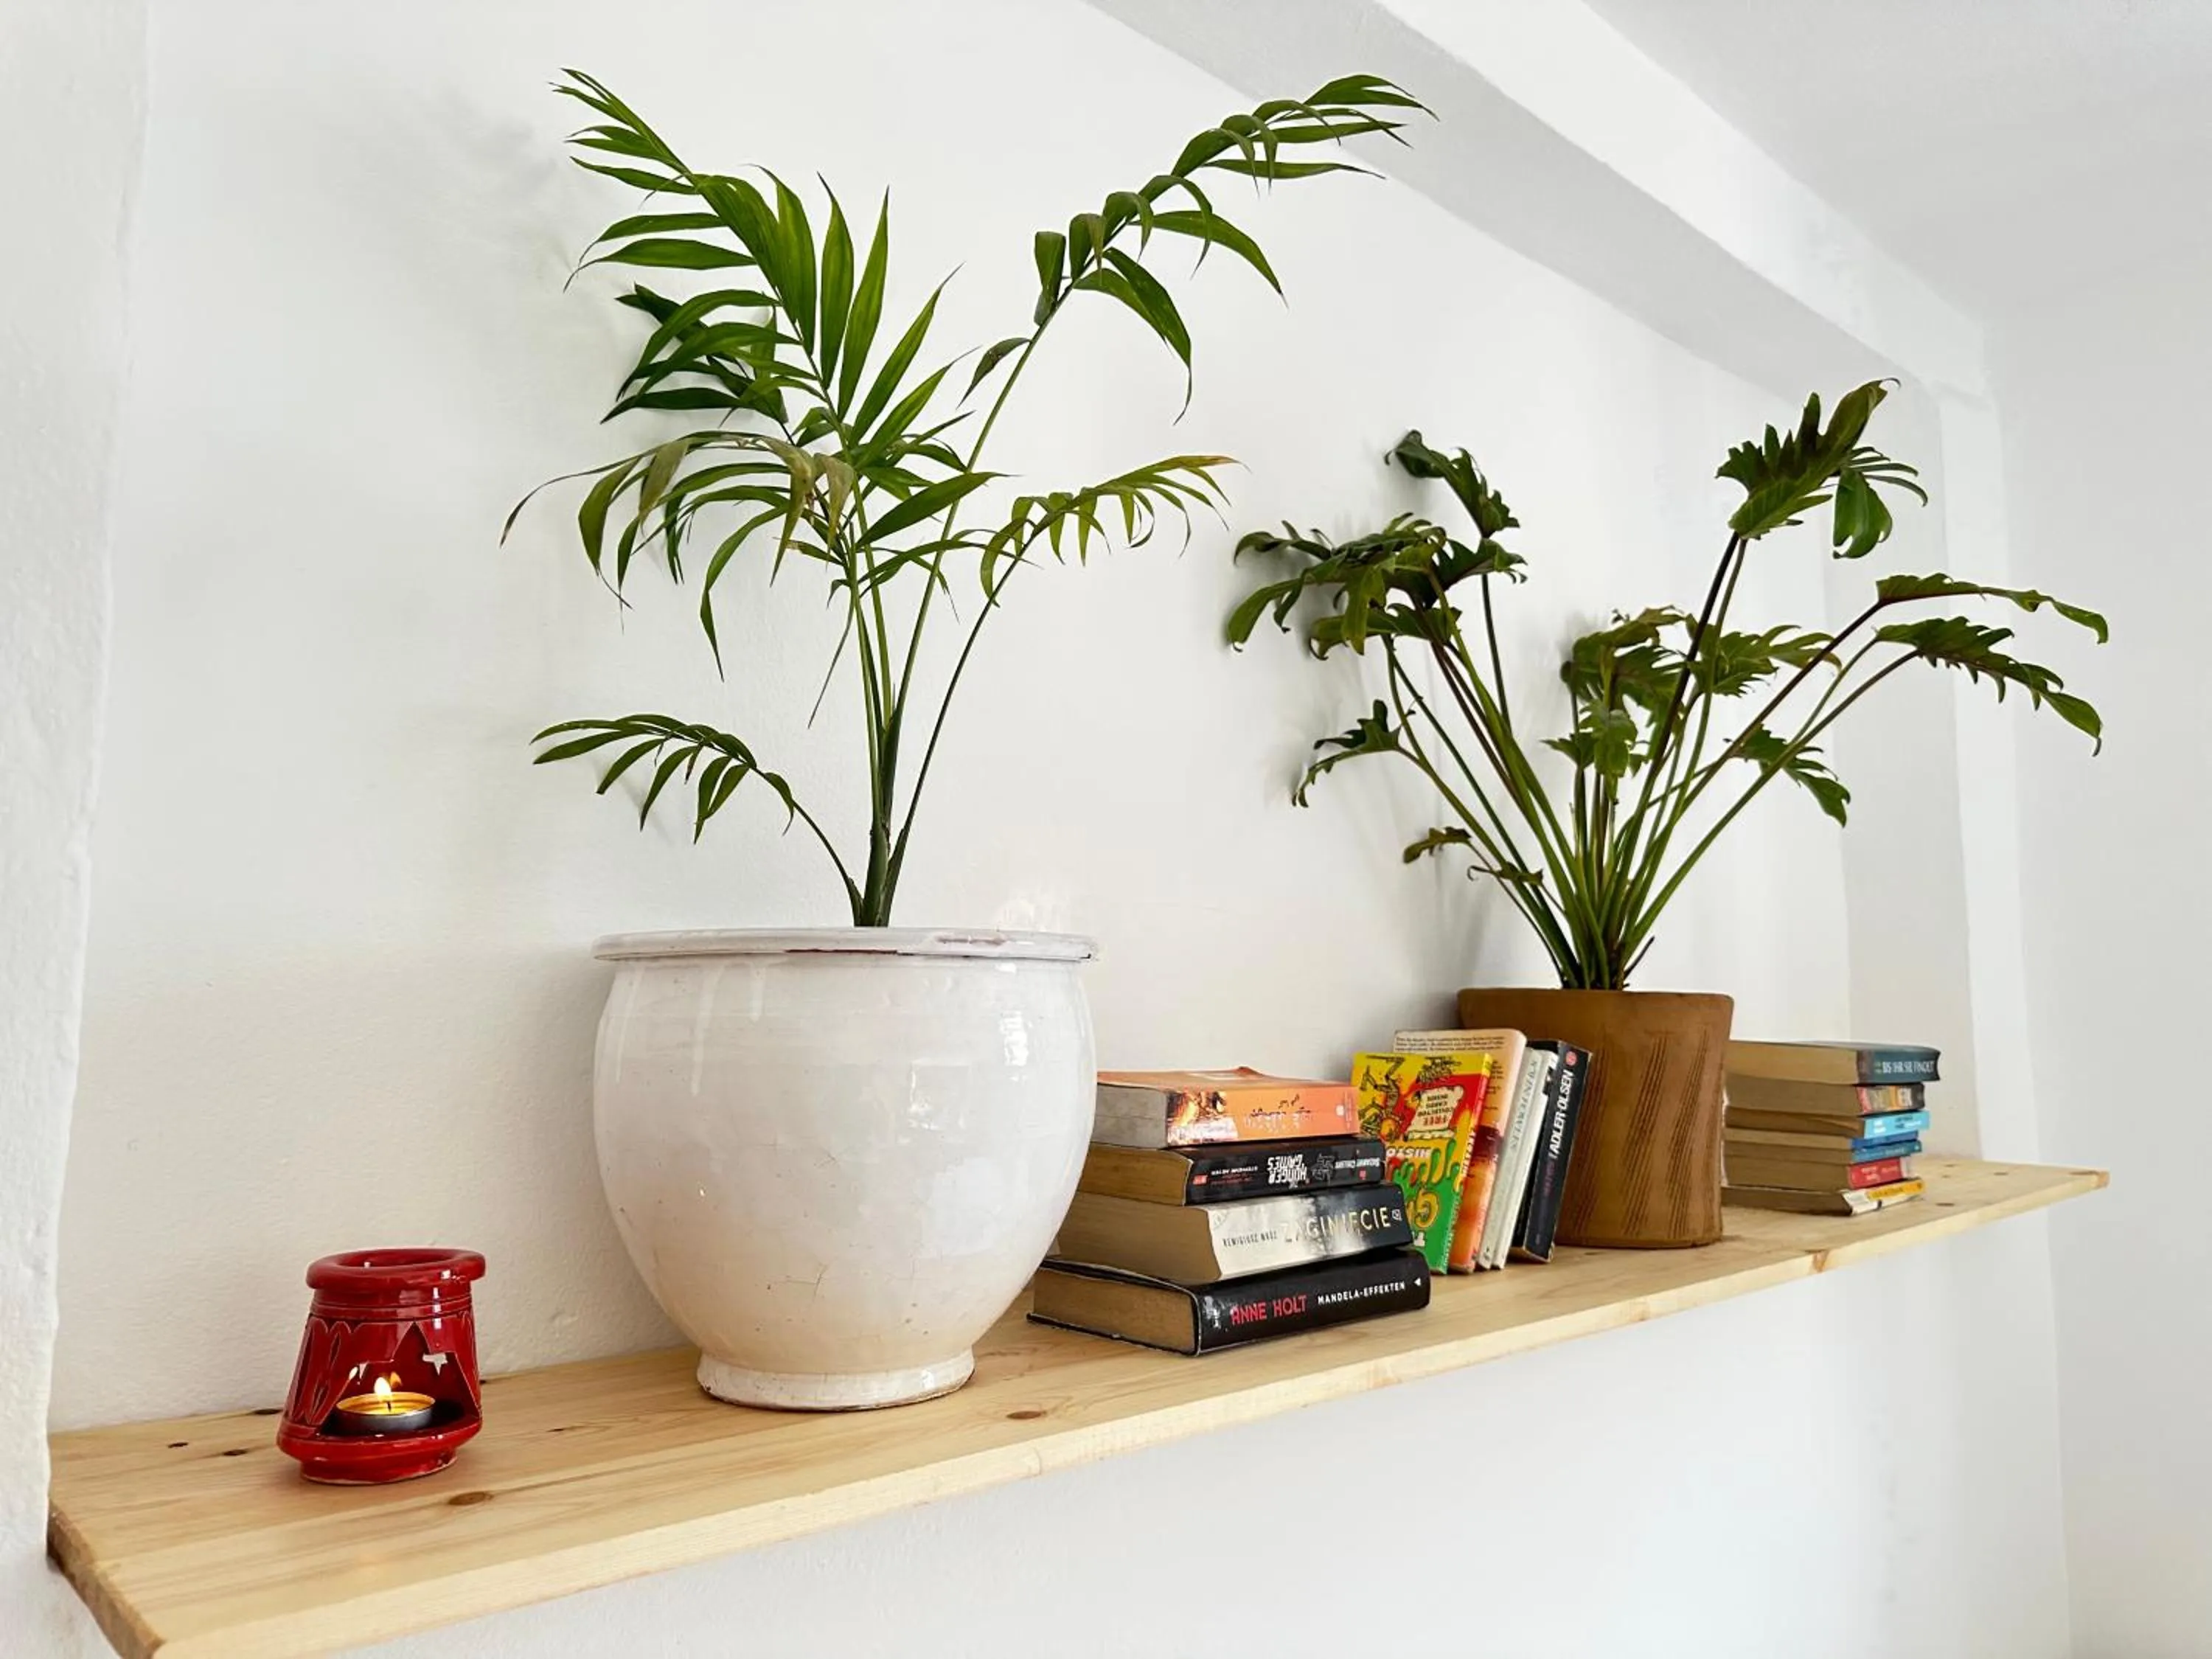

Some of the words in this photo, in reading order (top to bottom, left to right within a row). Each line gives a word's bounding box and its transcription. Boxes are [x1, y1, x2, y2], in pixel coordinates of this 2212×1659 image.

[1550, 1069, 1573, 1155] ADLER-OLSEN
[1386, 1145, 1432, 1158] HISTO
[1267, 1154, 1303, 1171] GAMES
[1268, 1164, 1307, 1184] HUNGER
[1230, 1302, 1267, 1325] ANNE
[1273, 1295, 1307, 1318] HOLT
[1318, 1281, 1405, 1304] MANDELA-EFFEKTEN
